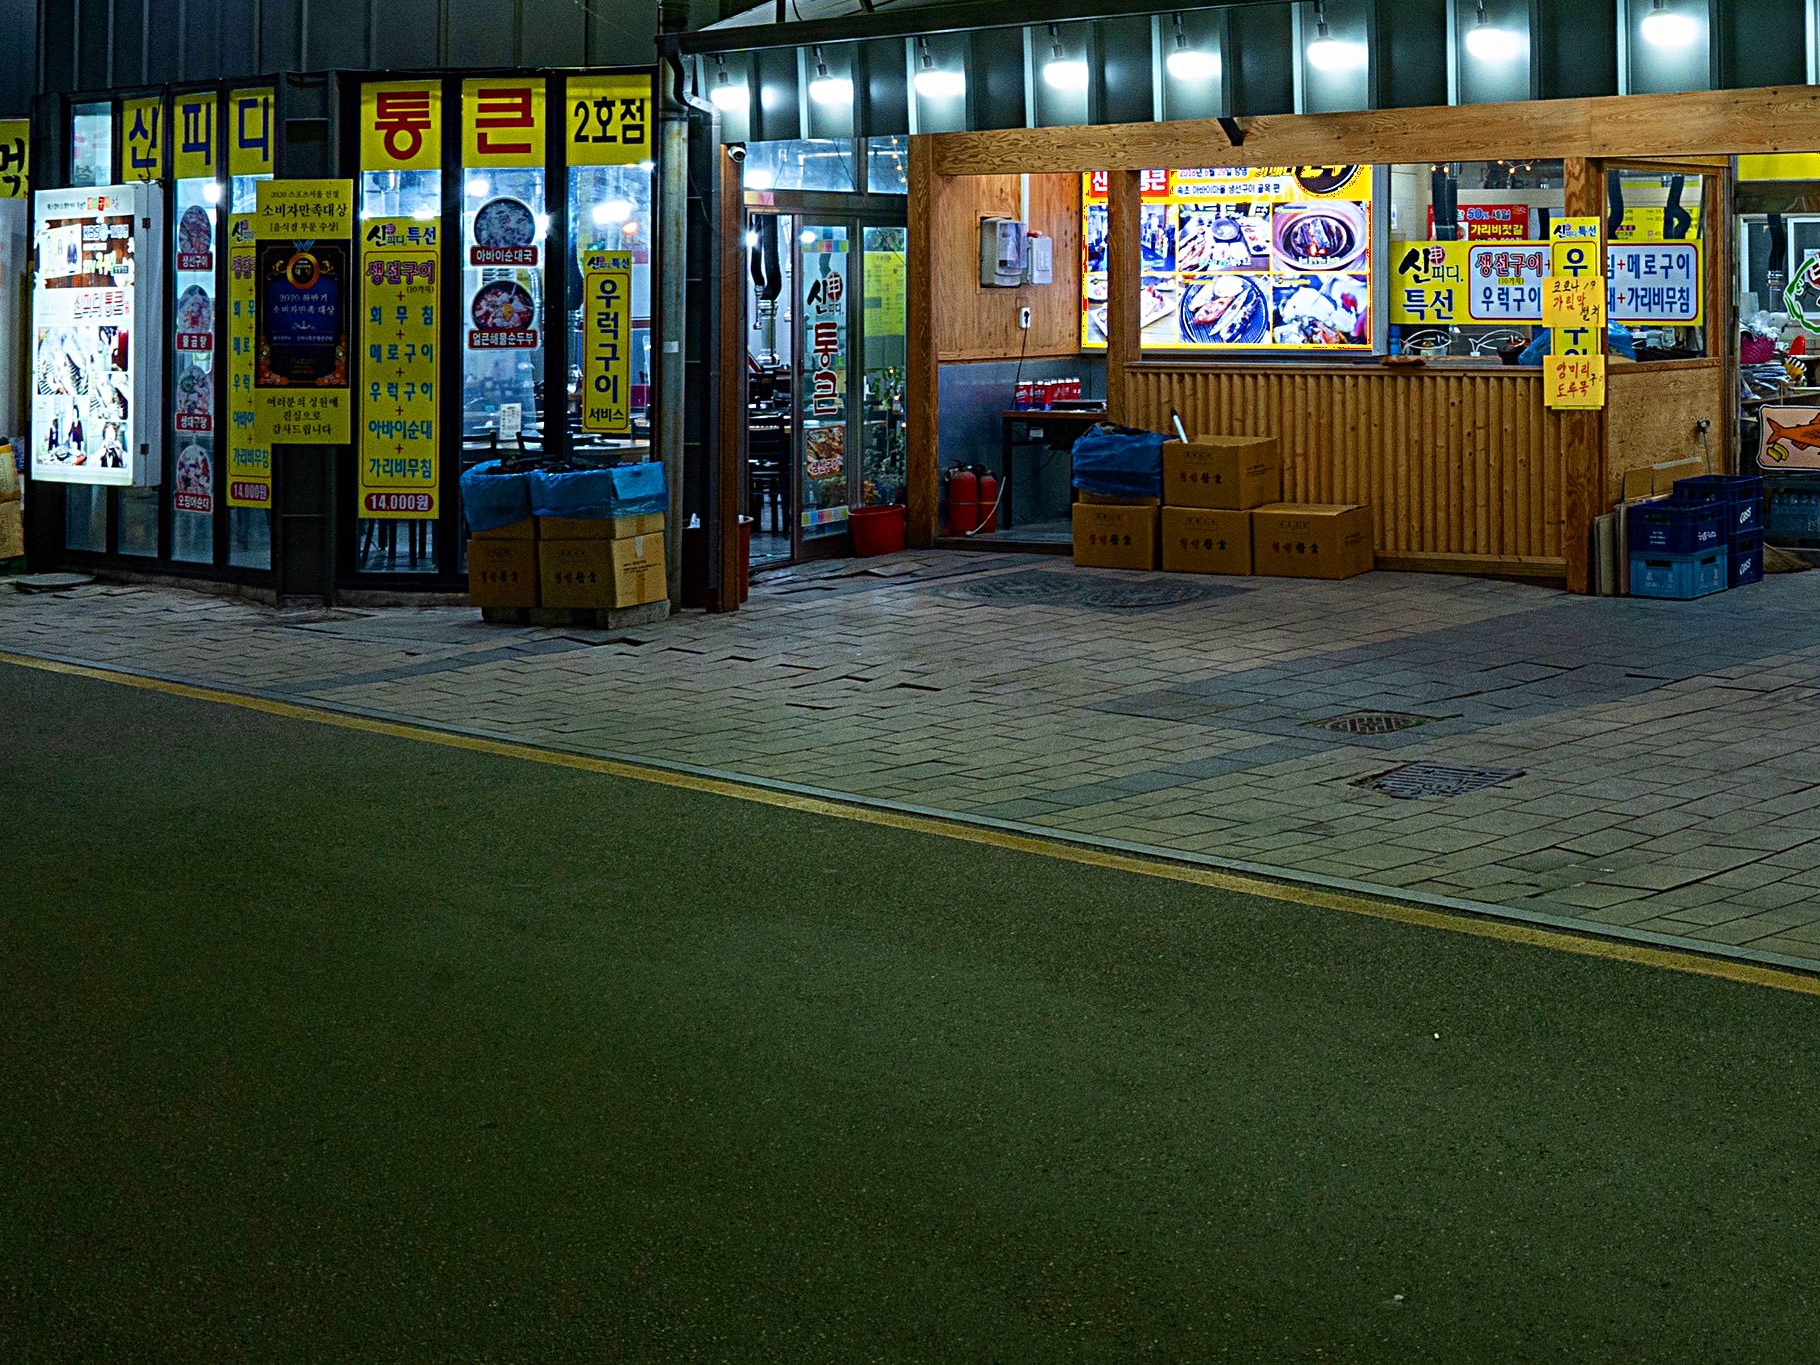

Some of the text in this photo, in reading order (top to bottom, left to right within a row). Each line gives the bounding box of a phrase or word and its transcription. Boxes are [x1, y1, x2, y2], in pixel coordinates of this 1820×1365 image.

[574, 96, 646, 146] 2호점
[1228, 184, 1255, 194] 생선구이
[262, 203, 348, 217] 소비자만족대상
[1467, 208, 1511, 220] 50% 세일
[407, 226, 437, 246] 특선
[1471, 223, 1524, 236] 가리비젓갈
[476, 249, 533, 262] 아바이순대국
[366, 261, 436, 285] 생선구이
[1552, 280, 1579, 293] 코로나
[279, 293, 300, 302] 2020
[1403, 289, 1454, 320] 특선
[1553, 292, 1586, 311] 가림막
[594, 279, 620, 404] 우럭구이
[369, 344, 433, 363] 메로구이
[813, 321, 839, 415] 통큰
[369, 382, 433, 402] 우럭구이
[1556, 380, 1589, 398] 도루묵
[267, 396, 339, 408] 여러분의 성원에
[283, 411, 323, 421] 진심으로
[589, 408, 624, 422] 서비스
[273, 423, 332, 435] 감사드립니다
[368, 420, 432, 440] 아바이순대
[369, 458, 432, 479] 가리비무침
